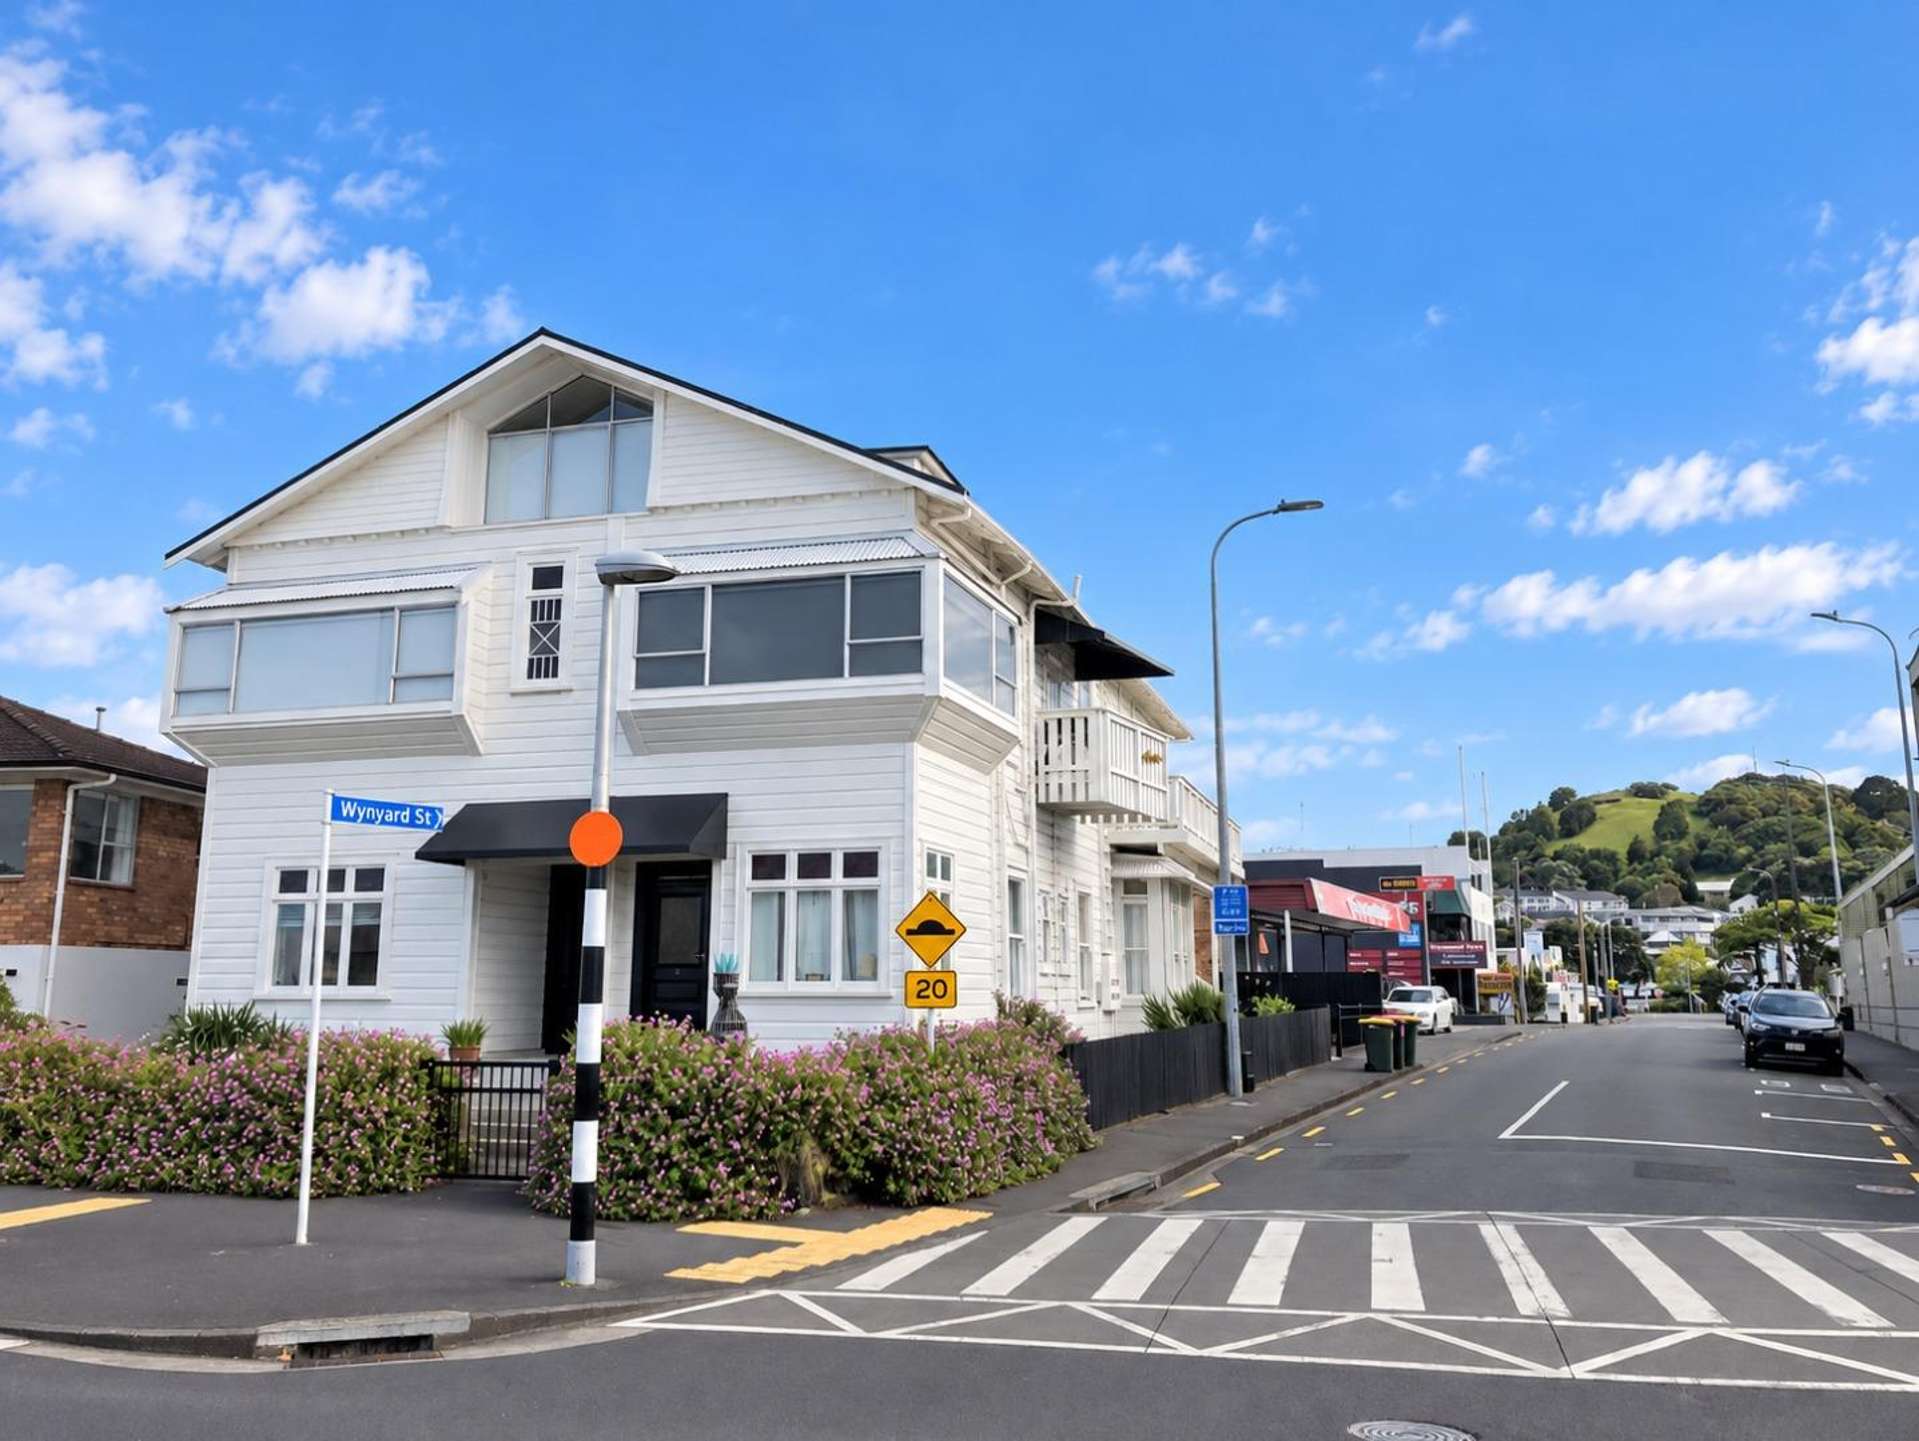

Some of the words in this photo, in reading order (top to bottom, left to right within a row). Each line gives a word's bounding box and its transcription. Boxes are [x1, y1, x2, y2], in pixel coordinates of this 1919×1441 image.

[341, 800, 410, 825] Wynyard
[415, 808, 432, 825] St
[916, 979, 947, 999] 20
